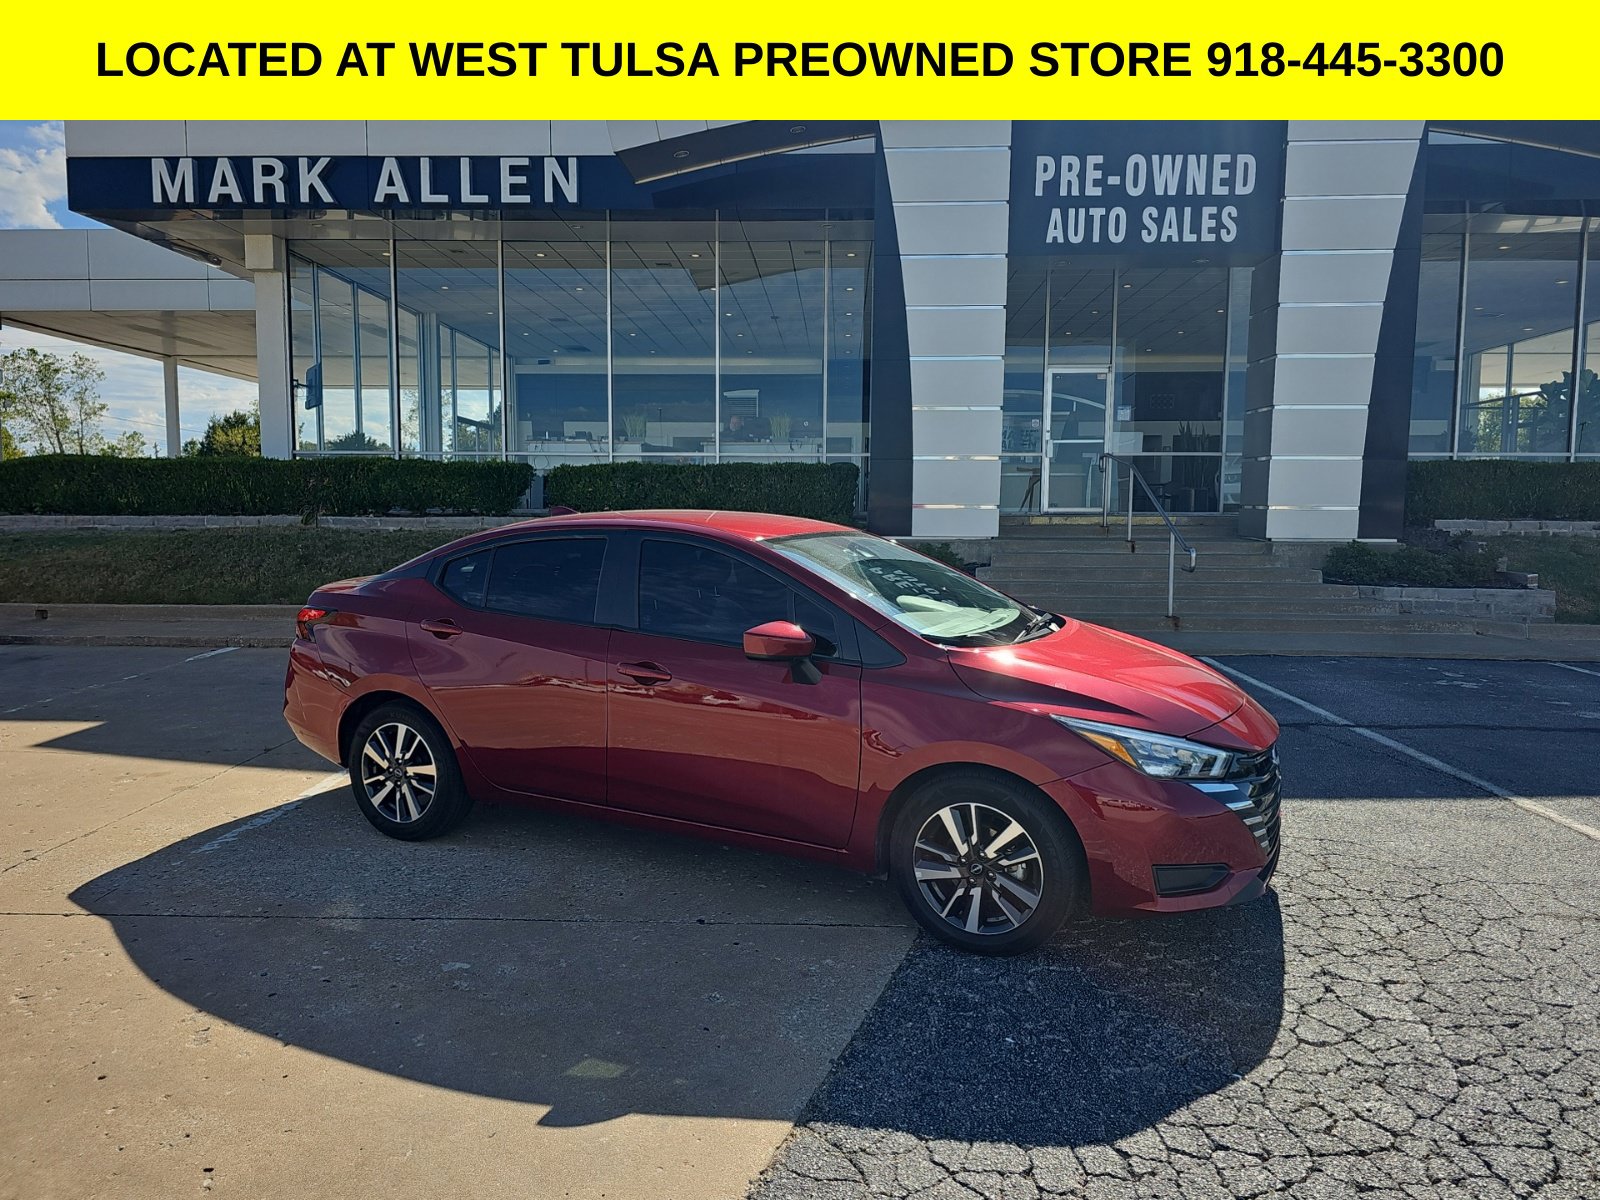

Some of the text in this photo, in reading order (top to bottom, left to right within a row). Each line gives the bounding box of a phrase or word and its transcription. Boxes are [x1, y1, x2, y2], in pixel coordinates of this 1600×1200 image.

[150, 156, 579, 204] MARK ALLEN
[1034, 153, 1257, 197] PRE-OWNED
[1045, 205, 1238, 243] AUTO SALES
